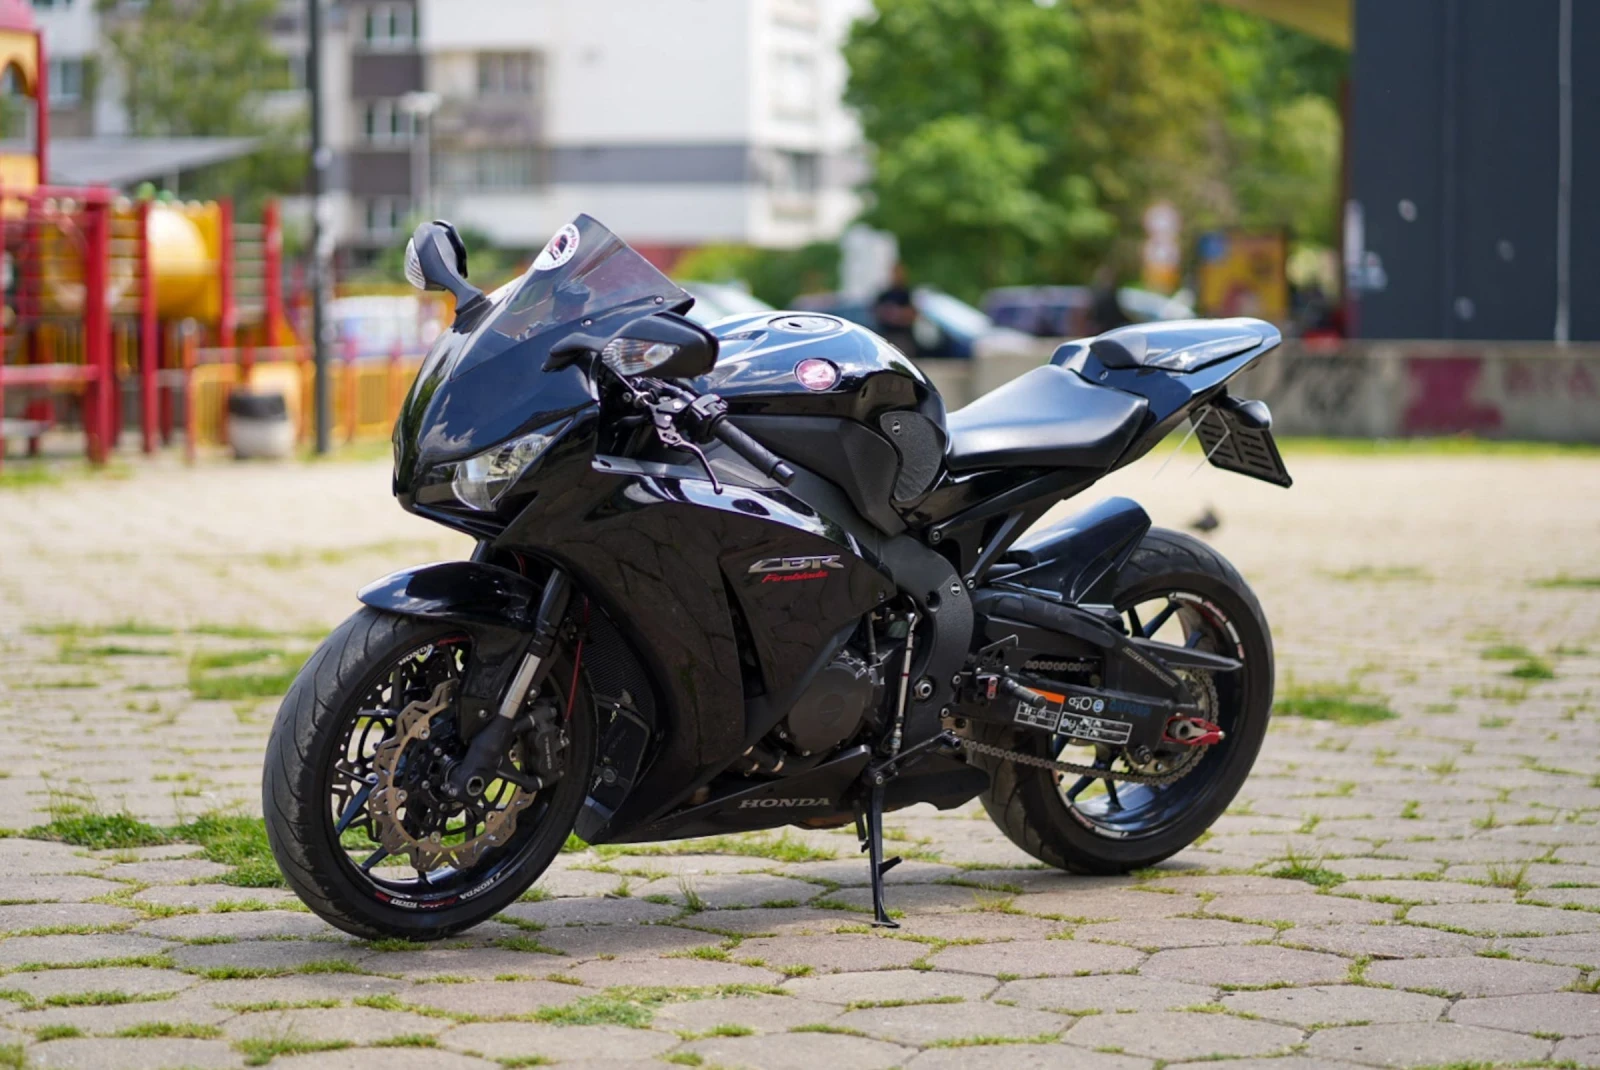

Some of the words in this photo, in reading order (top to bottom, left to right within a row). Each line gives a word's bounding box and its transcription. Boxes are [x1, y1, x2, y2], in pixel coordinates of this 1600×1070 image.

[748, 555, 844, 573] CBR
[739, 798, 830, 808] HONDA
[459, 878, 495, 899] HONDA
